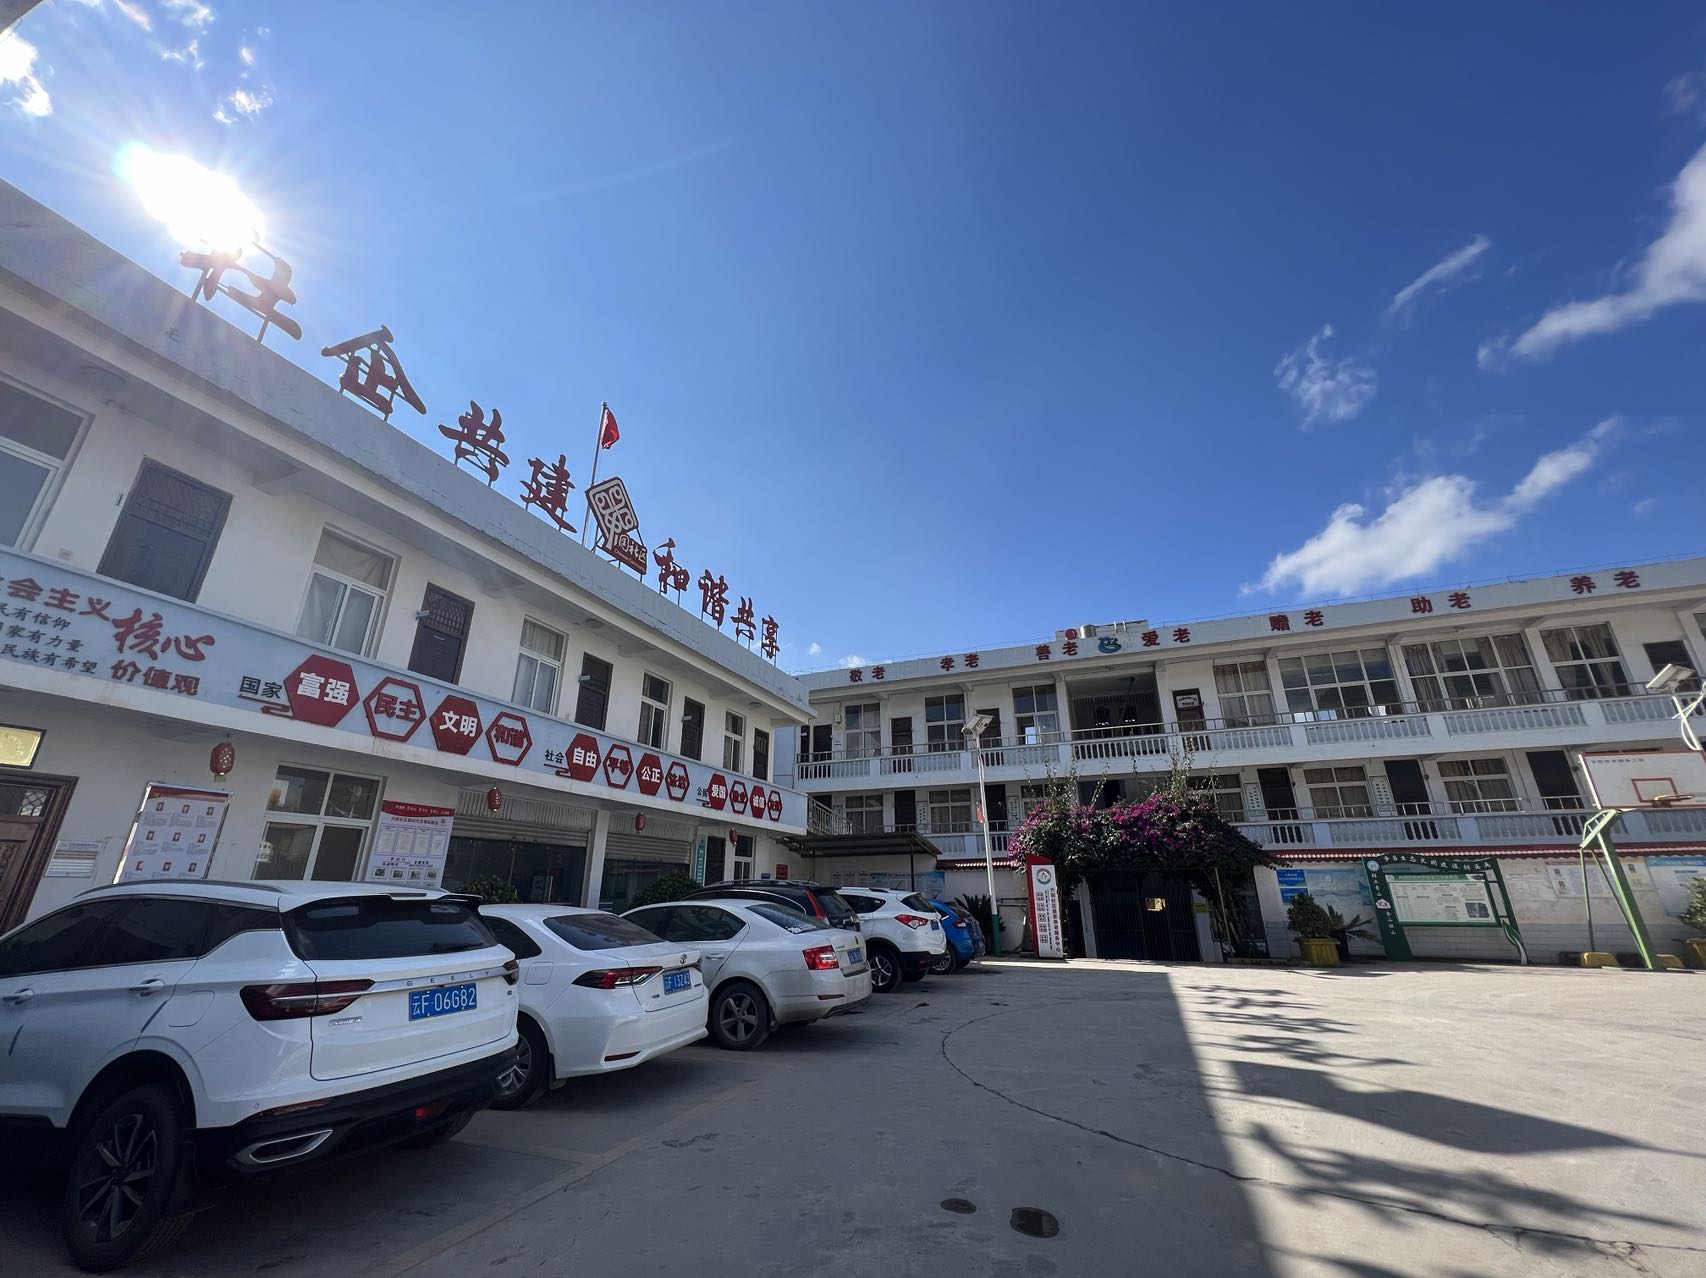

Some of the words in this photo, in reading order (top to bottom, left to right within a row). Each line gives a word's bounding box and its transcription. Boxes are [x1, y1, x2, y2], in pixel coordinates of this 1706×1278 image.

[652, 538, 780, 660] 和谐共享
[0, 576, 111, 622] 会主义
[112, 608, 215, 661] 核心
[0, 620, 84, 653] 家有力量
[850, 666, 885, 683] 敬老
[940, 652, 979, 672] 孝老
[1036, 641, 1079, 661] 善老
[1141, 627, 1191, 647] 爱老
[1269, 610, 1324, 632] 赡老
[1410, 592, 1472, 614] 助老
[1570, 570, 1641, 595] 养老
[1, 643, 98, 675] 民族有希望
[111, 659, 200, 696] 价值观
[240, 675, 283, 699] 国家
[296, 672, 350, 706] 富强
[374, 693, 419, 722] 民主
[440, 710, 478, 738] 文明
[545, 749, 565, 764] 社会
[572, 747, 598, 768] 自由
[641, 765, 662, 784] 公正
[711, 783, 727, 800] 爱国
[406, 970, 491, 987] GEELY
